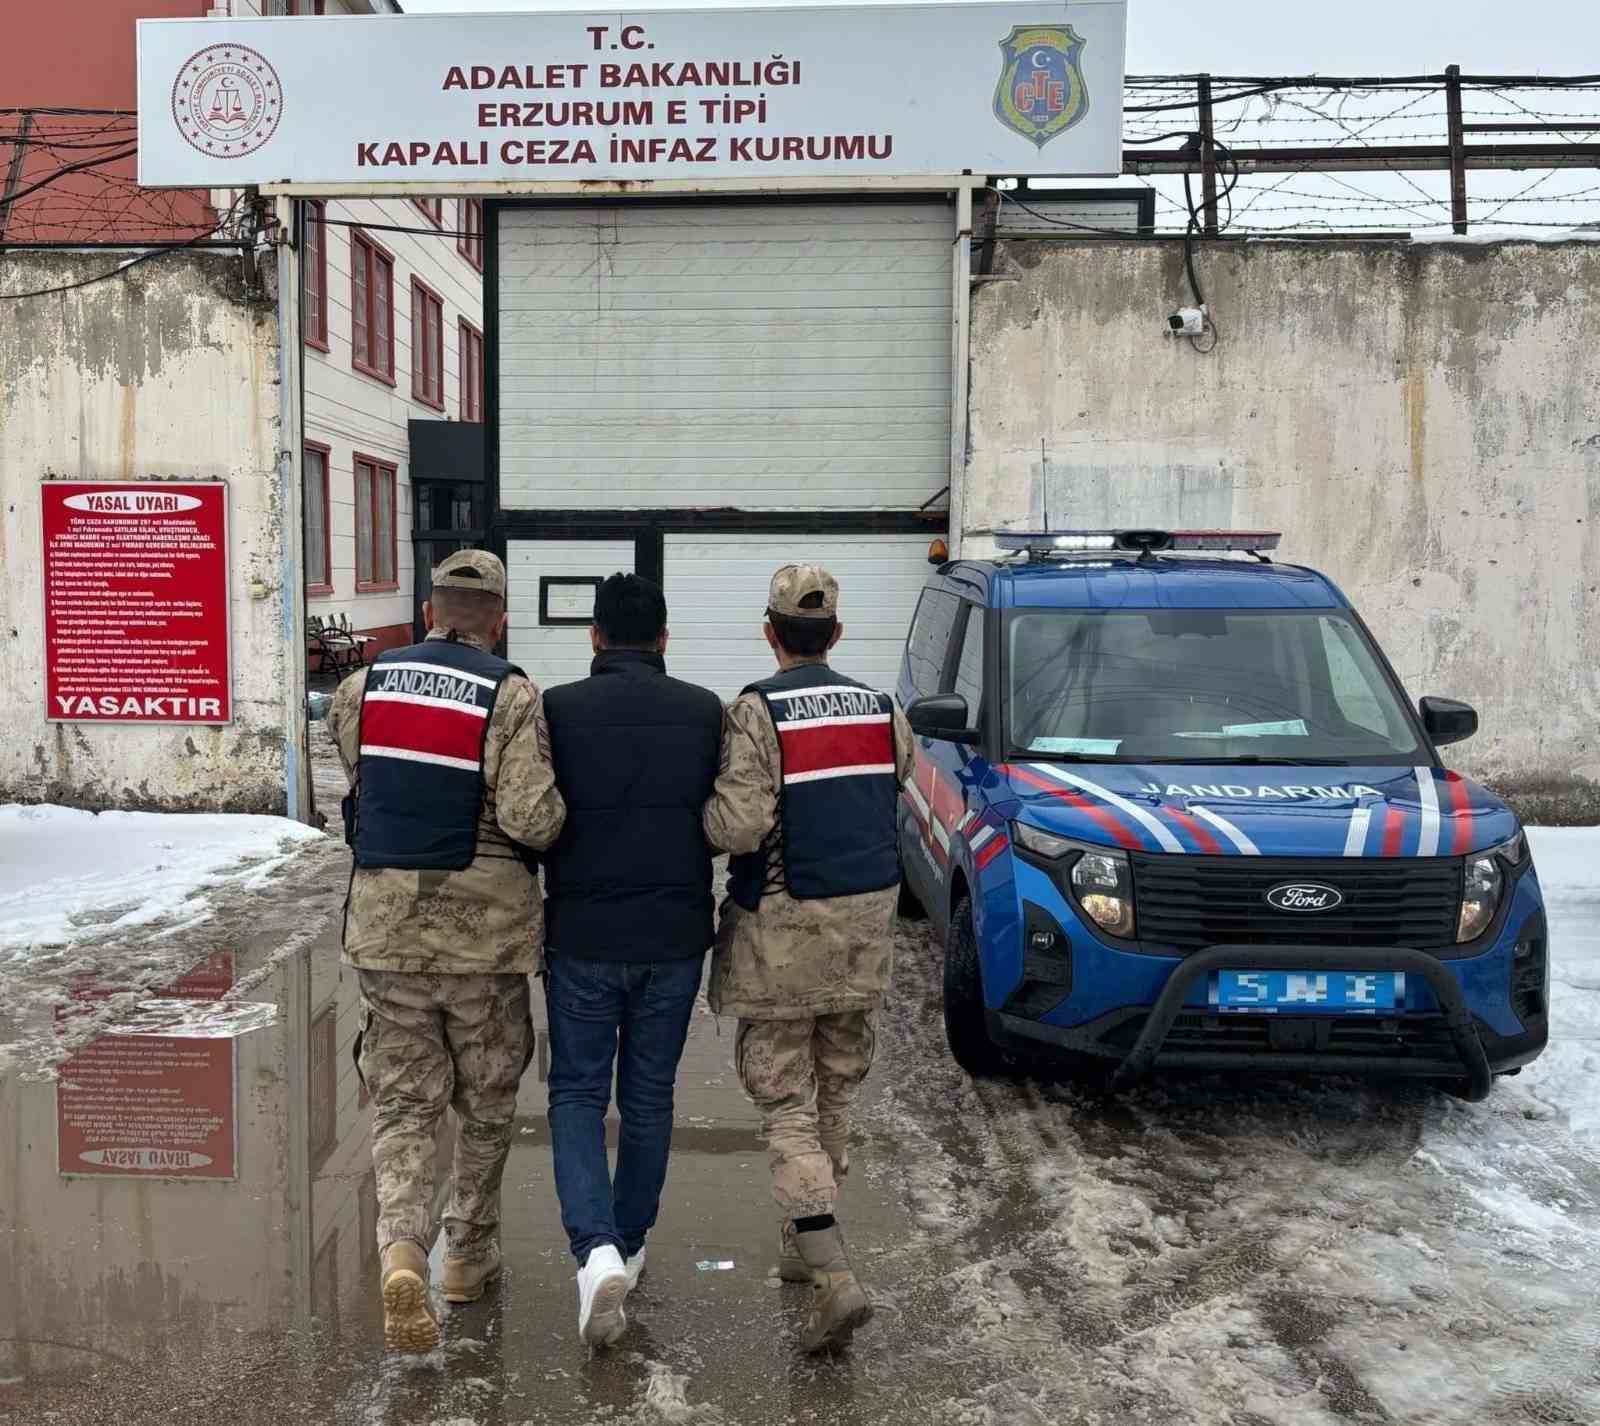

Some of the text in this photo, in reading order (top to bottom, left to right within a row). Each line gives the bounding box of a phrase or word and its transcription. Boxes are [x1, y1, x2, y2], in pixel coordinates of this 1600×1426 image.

[587, 26, 655, 50] T.C.
[442, 54, 801, 90] ADALET BAKANLIĞI
[1015, 70, 1065, 113] CTE
[478, 93, 767, 127] ERZURUM E TİPİ
[357, 132, 893, 167] KAPALI CEZA İNFAZ KURUMU
[86, 495, 179, 511] YASAL UYARI
[377, 669, 478, 705] JANDARMA
[55, 695, 221, 717] YASAKTIR
[785, 692, 882, 721] JANDARMA
[1141, 783, 1385, 801] JANDARMA
